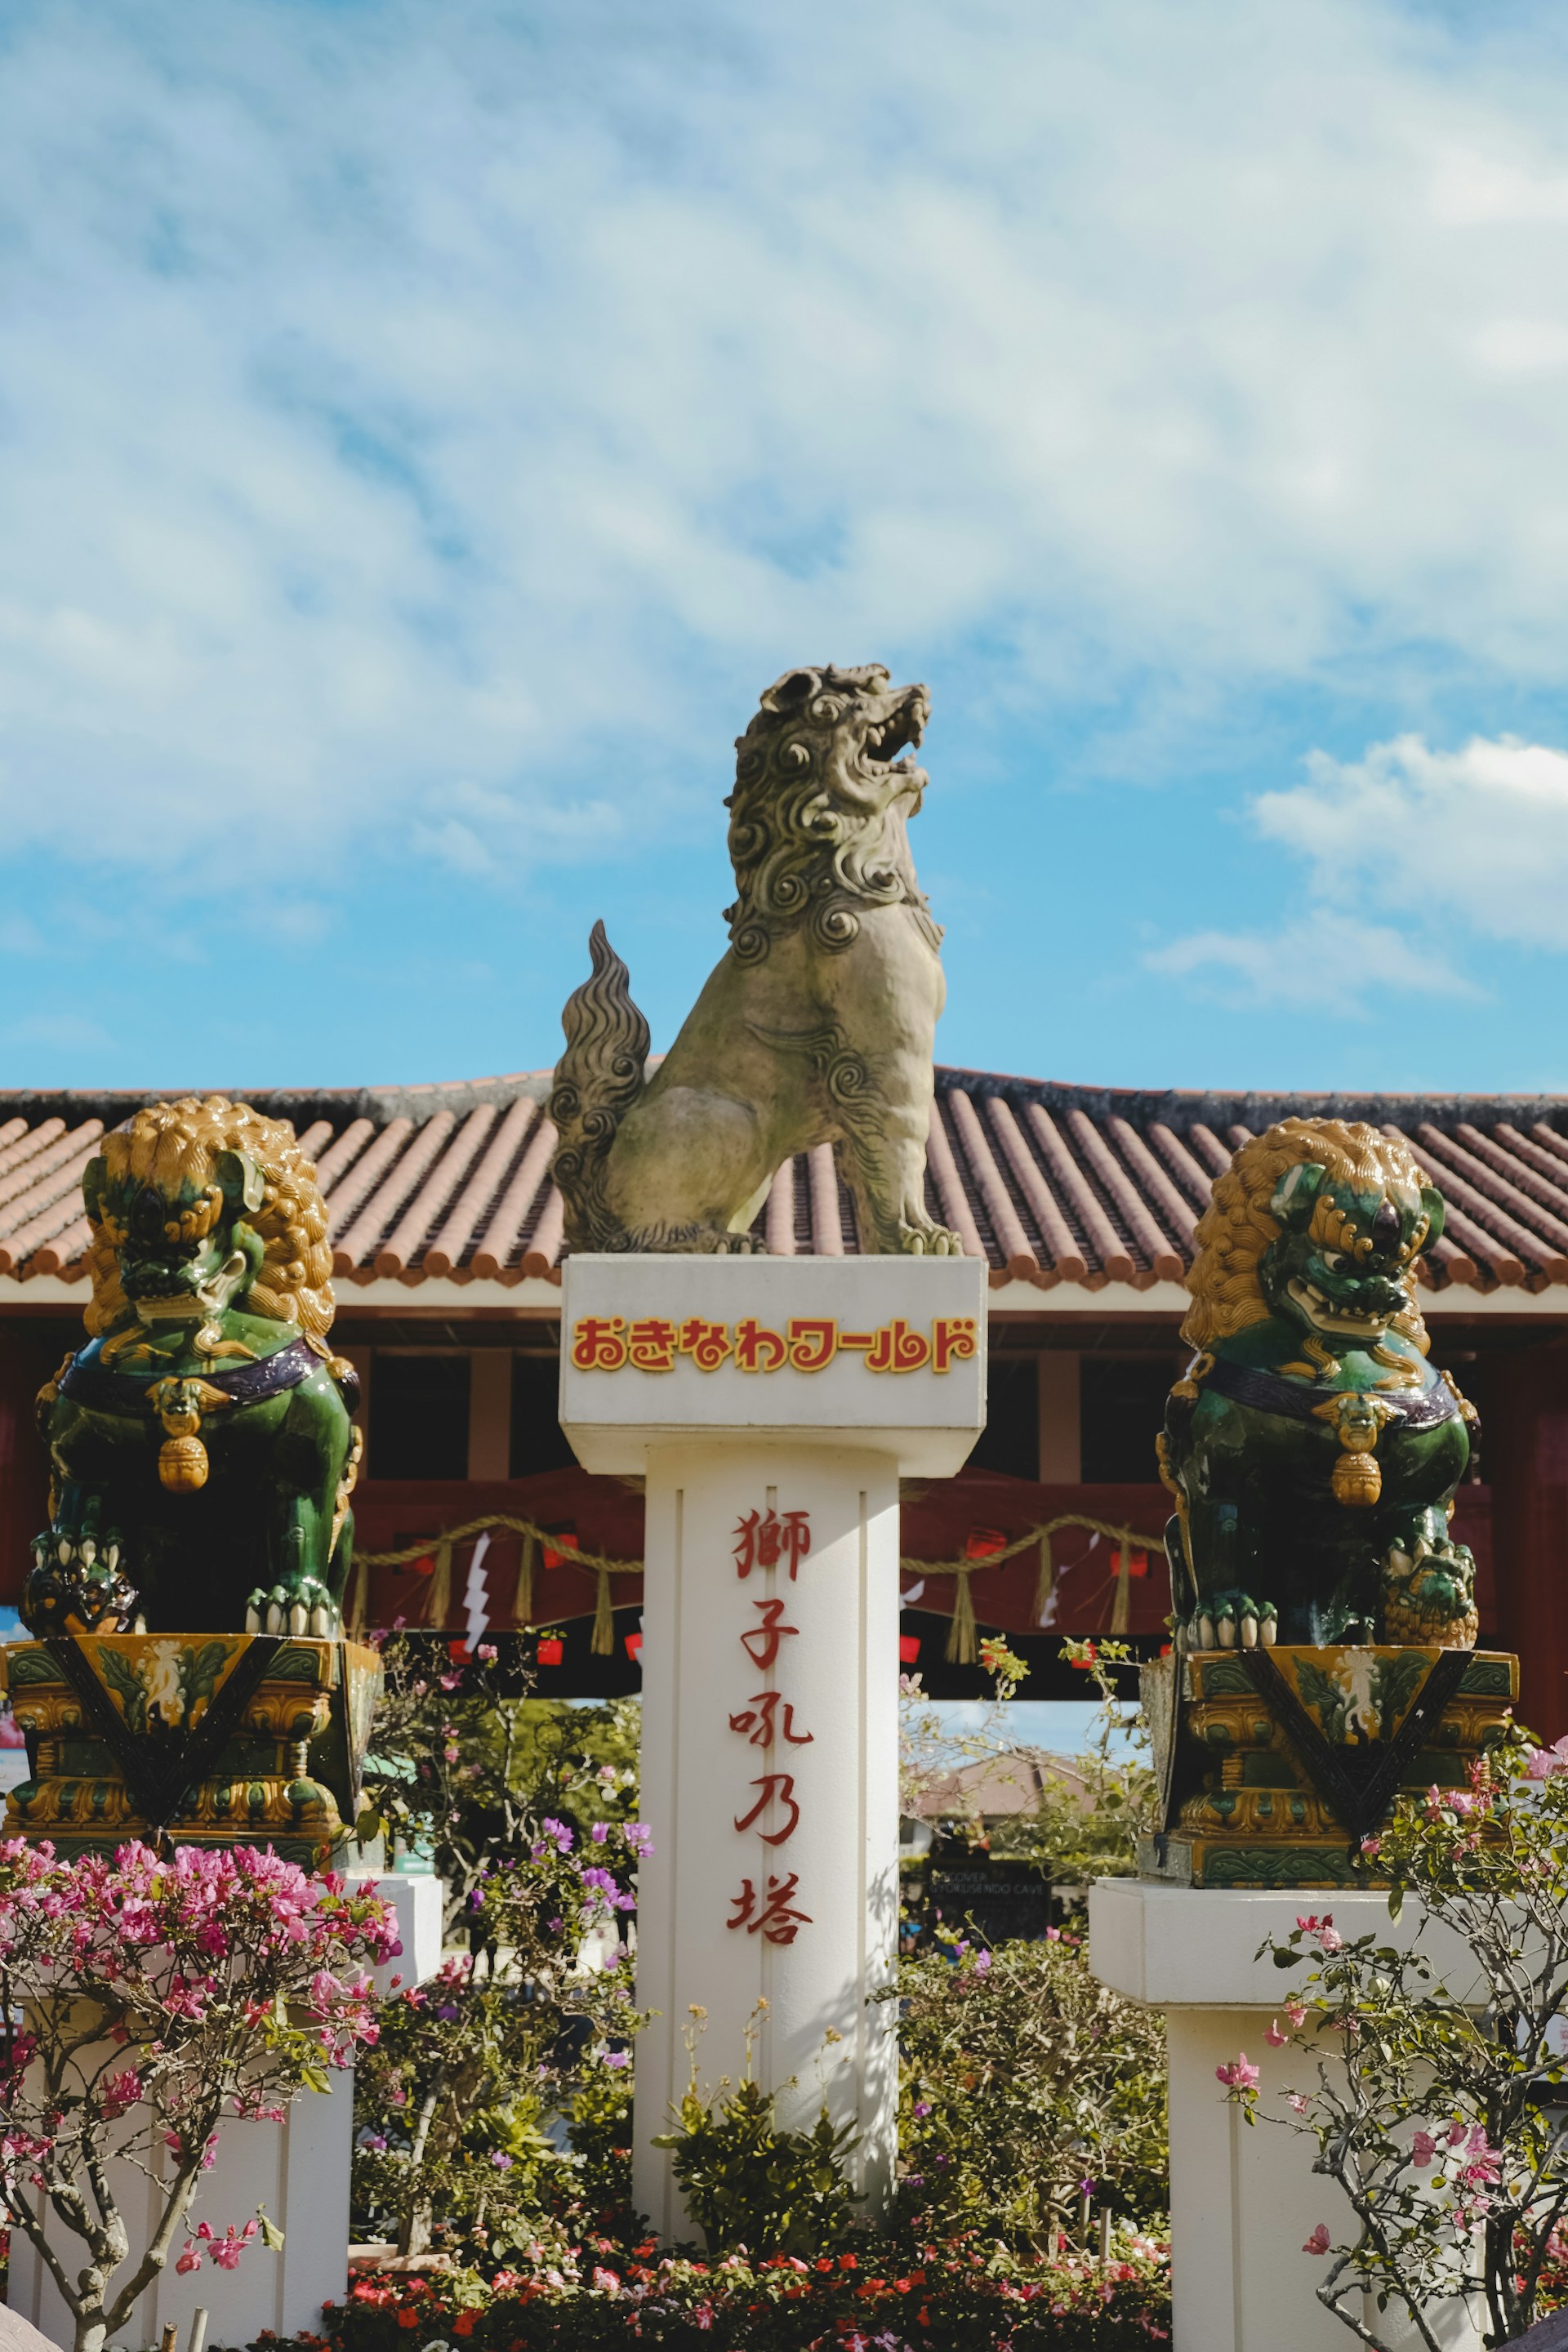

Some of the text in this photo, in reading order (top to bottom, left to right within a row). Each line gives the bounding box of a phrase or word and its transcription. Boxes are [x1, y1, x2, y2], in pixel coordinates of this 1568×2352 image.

[572, 1316, 977, 1374] おきなわワールド
[726, 1508, 813, 1944] 獅子吼乃塔
[929, 1872, 987, 1882] COVER
[1013, 1884, 1043, 1895] CAVE
